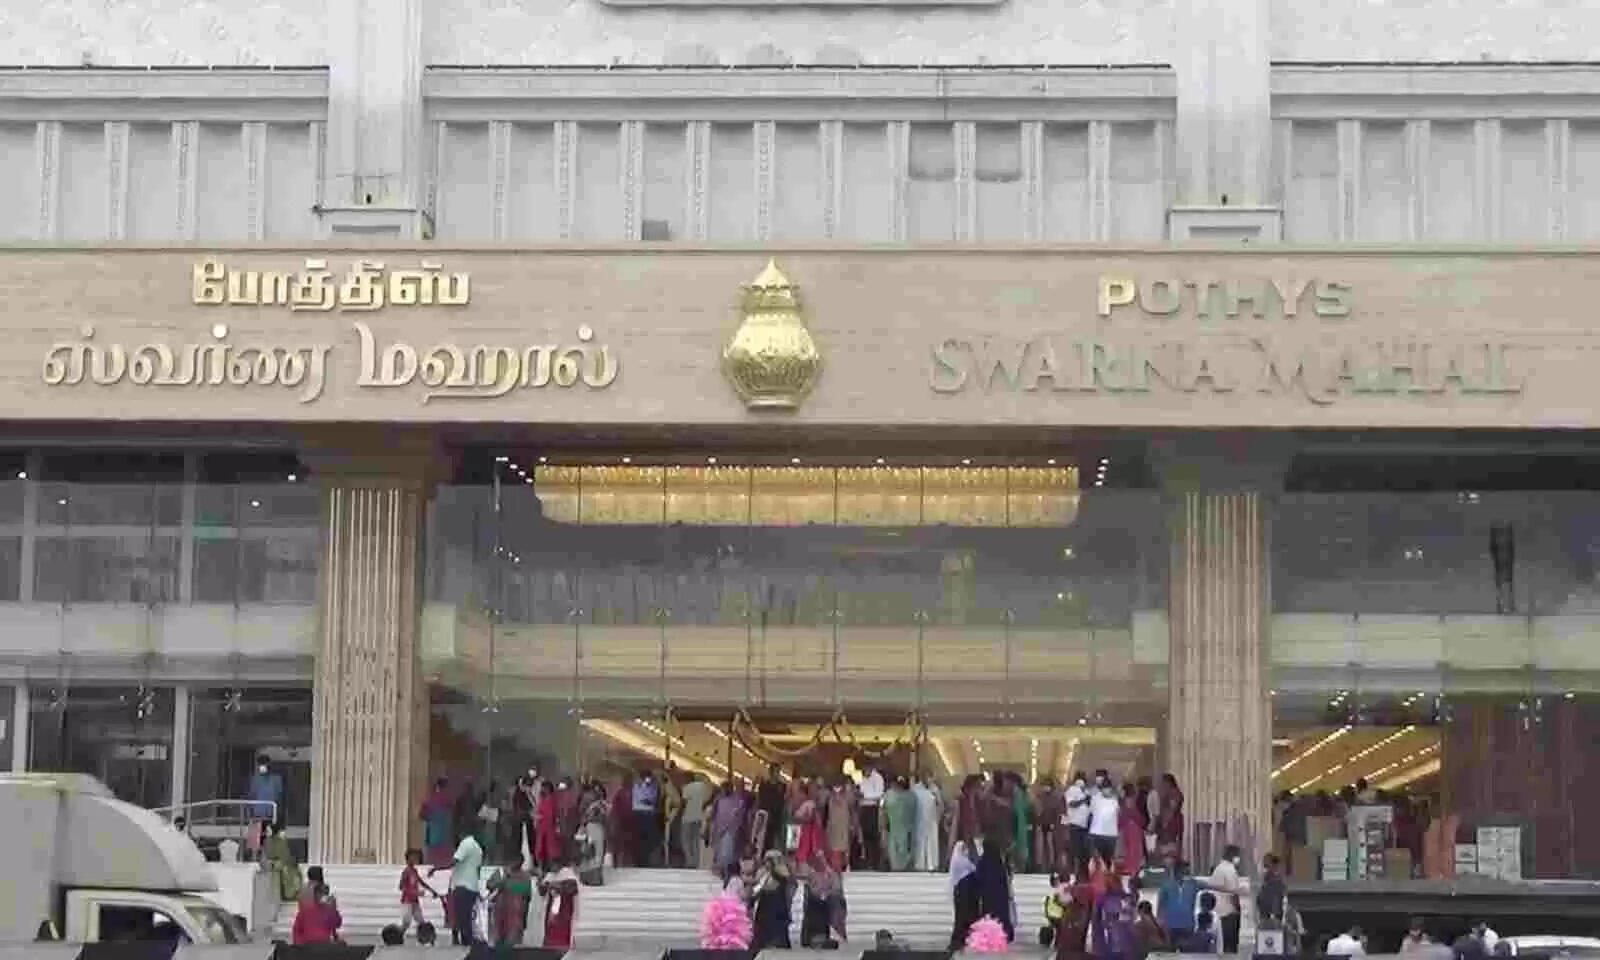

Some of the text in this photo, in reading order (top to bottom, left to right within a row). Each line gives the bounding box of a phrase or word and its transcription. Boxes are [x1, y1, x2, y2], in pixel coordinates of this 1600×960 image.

[1097, 277, 1352, 319] POTHYS
[42, 320, 619, 405] ஸ்வர்ண மஹால்
[929, 337, 1524, 406] SWARNA MAHAL
